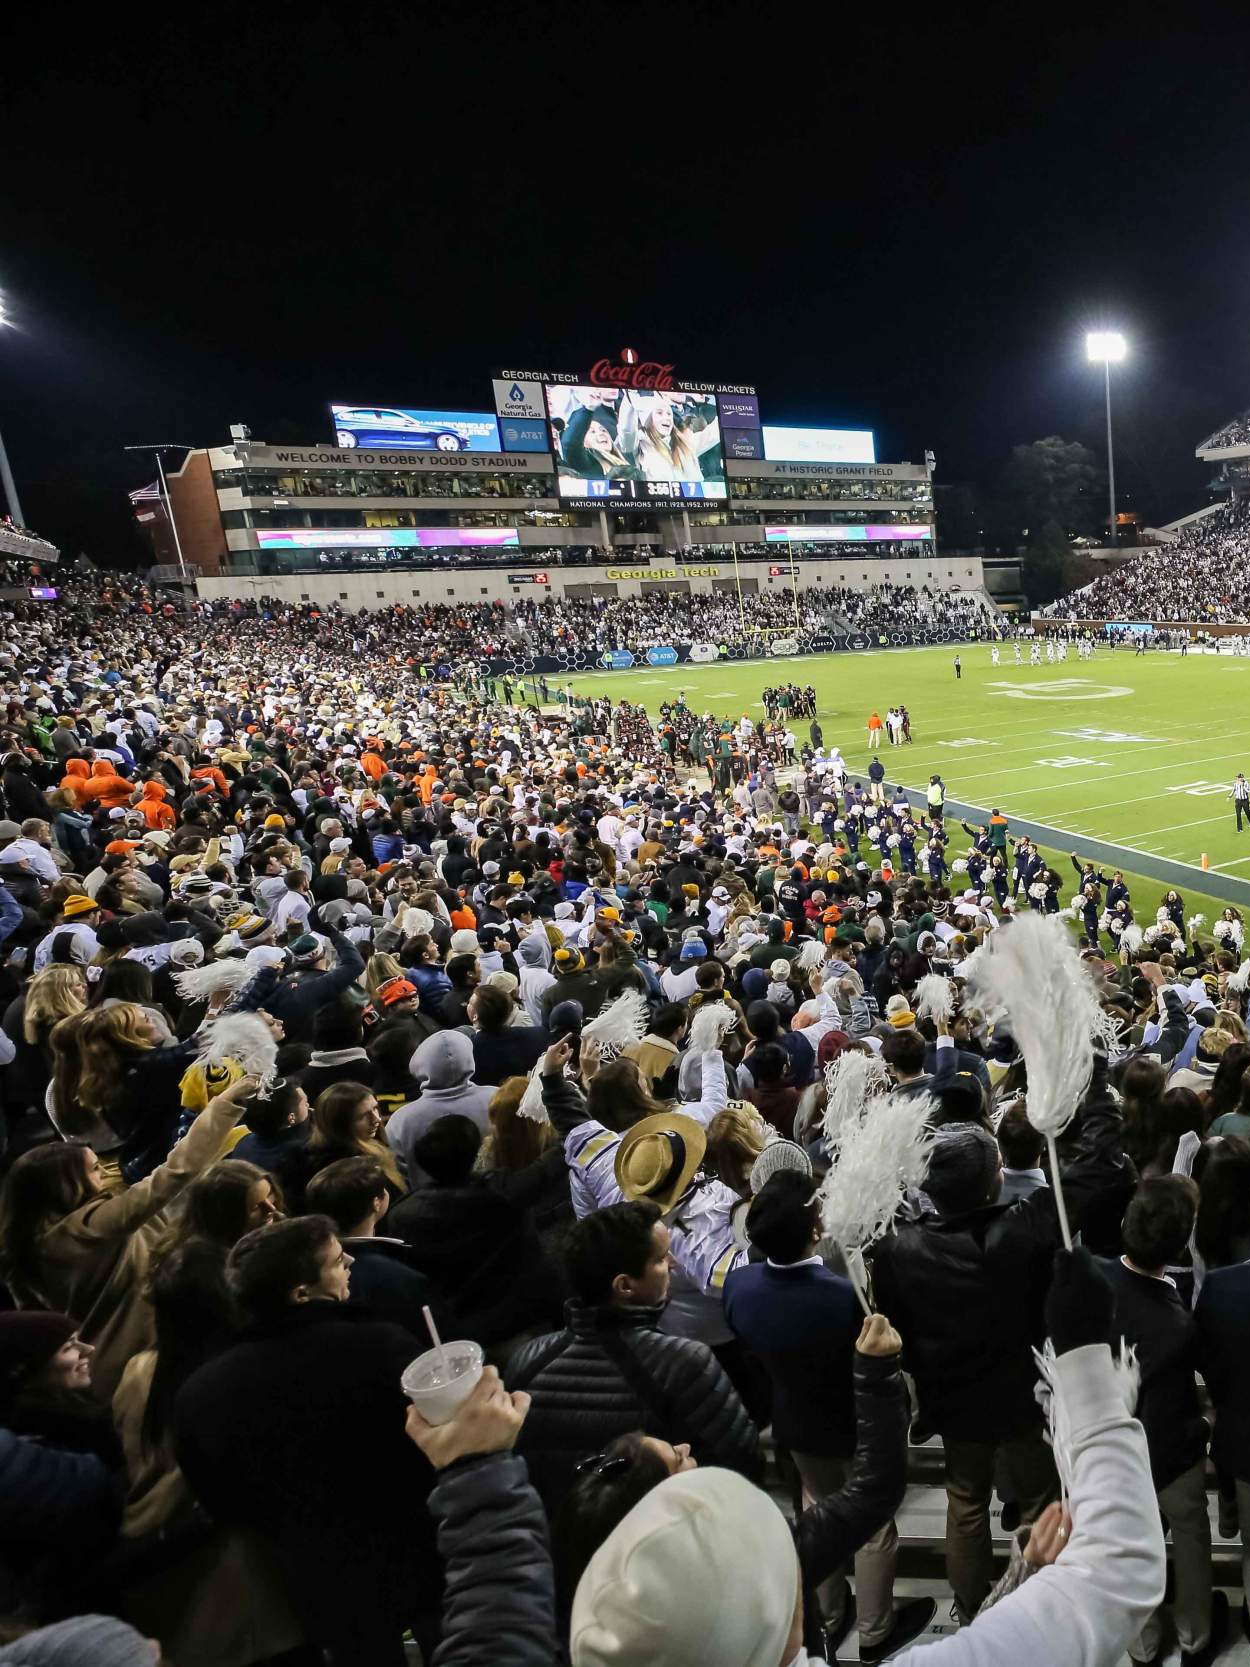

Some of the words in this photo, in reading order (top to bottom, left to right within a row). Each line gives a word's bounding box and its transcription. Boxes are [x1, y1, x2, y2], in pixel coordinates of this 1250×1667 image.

[502, 370, 550, 382] GEORGIA
[552, 373, 579, 383] TECH
[678, 382, 715, 392] YELLOW
[717, 385, 756, 395] JACKETS
[505, 402, 533, 412] Georgia
[500, 409, 527, 417] Natural
[520, 431, 544, 440] AT&T
[276, 452, 351, 464] WELCOME
[357, 454, 375, 464] TO
[379, 455, 425, 465] BOBBY
[430, 456, 468, 466] DODD
[472, 457, 528, 468] STADIUM
[774, 465, 786, 473] AT
[789, 466, 833, 475] HISTORIC
[836, 467, 866, 475] GRANT
[868, 468, 893, 476] FIELD
[607, 568, 677, 581] Georgia
[682, 566, 720, 577] Tech
[773, 642, 797, 652] sage
